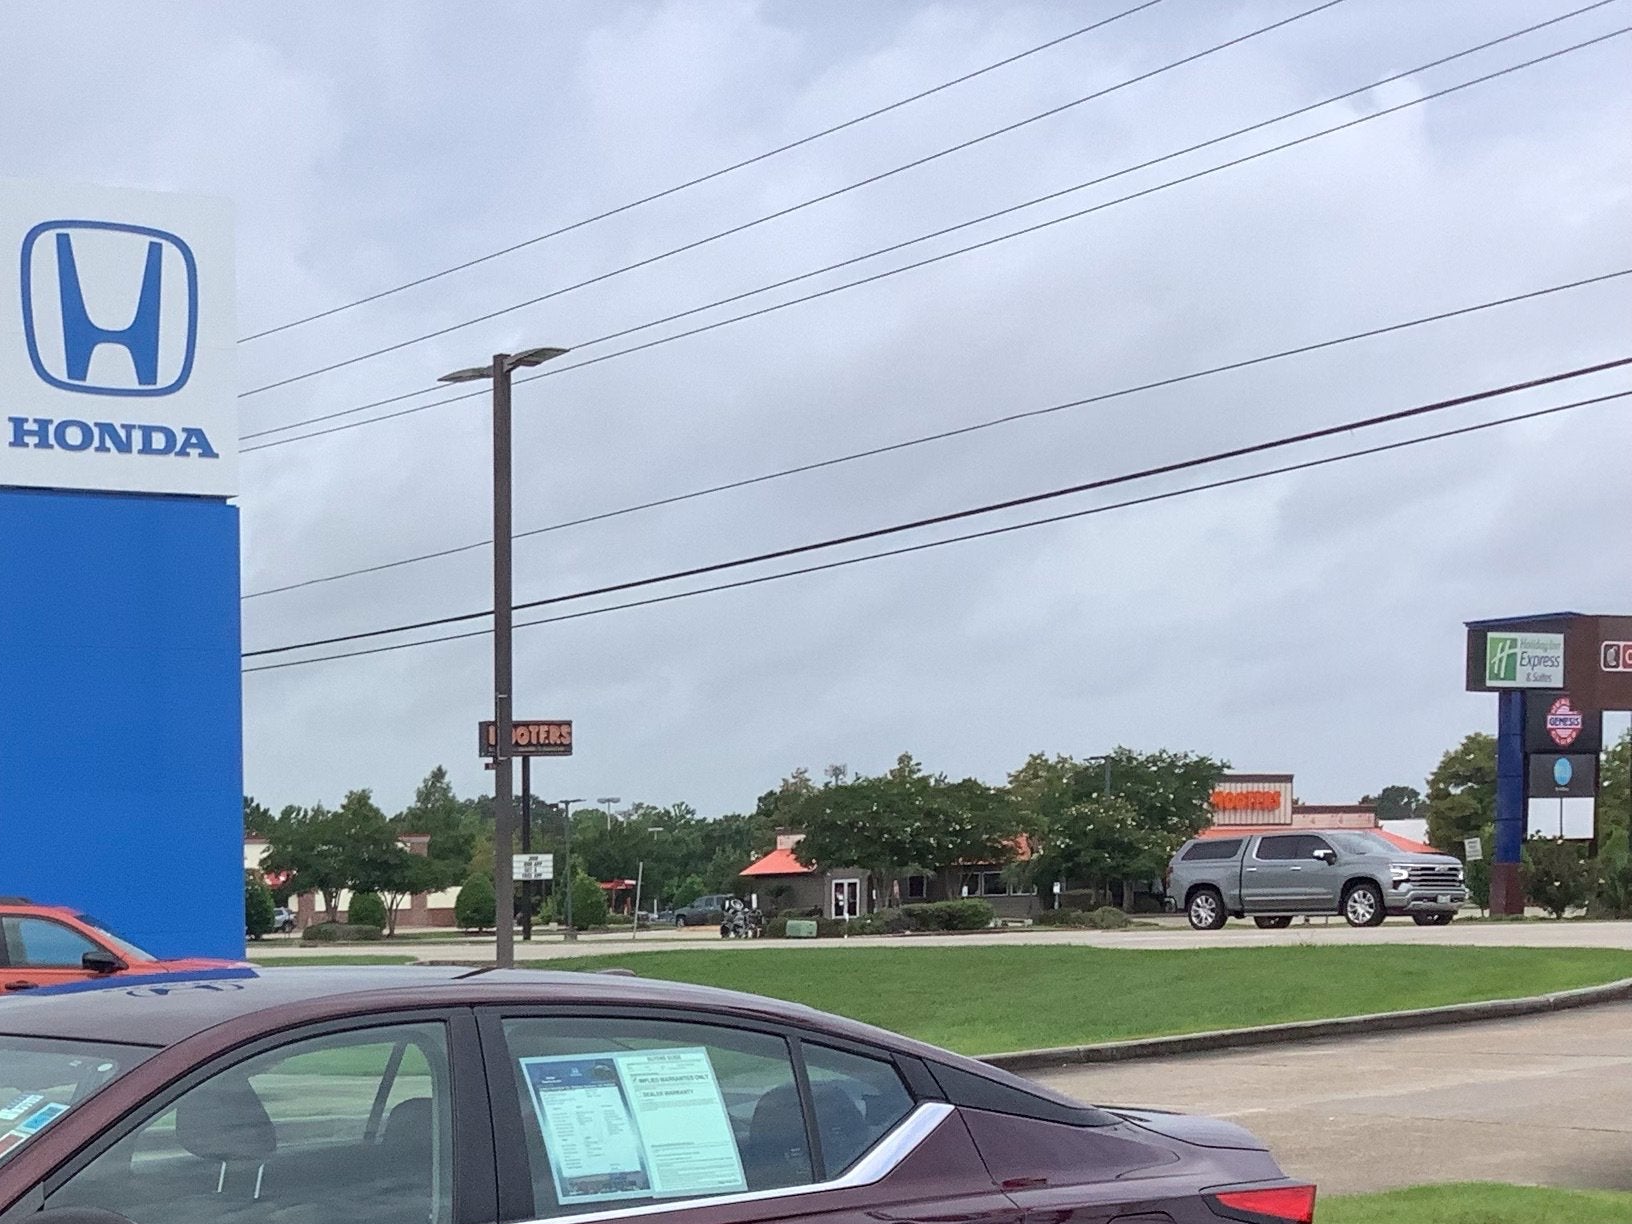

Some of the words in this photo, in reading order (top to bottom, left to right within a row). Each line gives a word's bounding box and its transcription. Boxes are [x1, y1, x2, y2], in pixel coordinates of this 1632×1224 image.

[8, 416, 219, 458] HONDA
[1520, 651, 1561, 670] Express
[1549, 717, 1580, 726] GENESIS
[489, 725, 571, 745] OTERS
